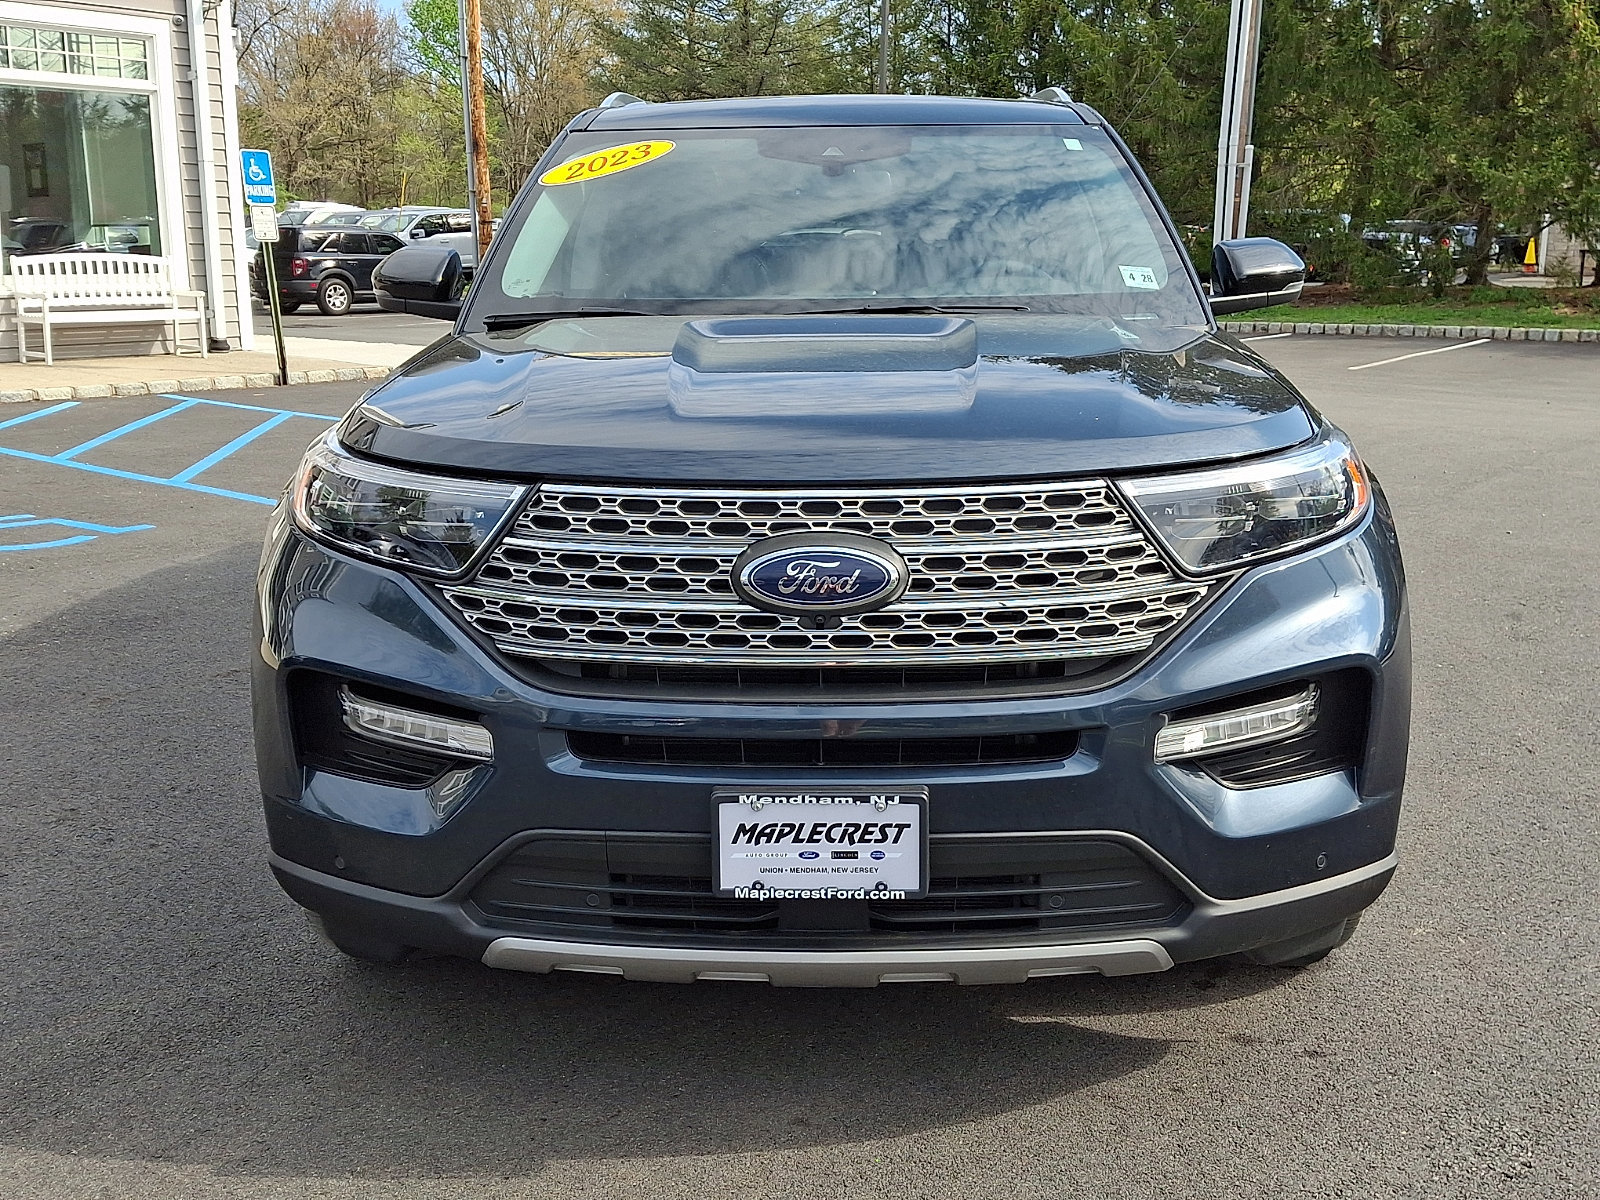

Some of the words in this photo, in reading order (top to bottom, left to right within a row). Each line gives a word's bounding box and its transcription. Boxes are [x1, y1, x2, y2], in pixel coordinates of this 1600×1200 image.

[566, 145, 651, 180] 2023
[246, 185, 274, 197] PARKING
[1141, 274, 1153, 283] 28
[778, 560, 861, 594] Ford
[739, 795, 861, 806] Mendham,
[870, 795, 900, 805] NJ
[731, 823, 911, 846] MAPLECREST
[789, 867, 830, 875] MENDHAM,
[734, 886, 906, 900] MaplecrestFord.com
